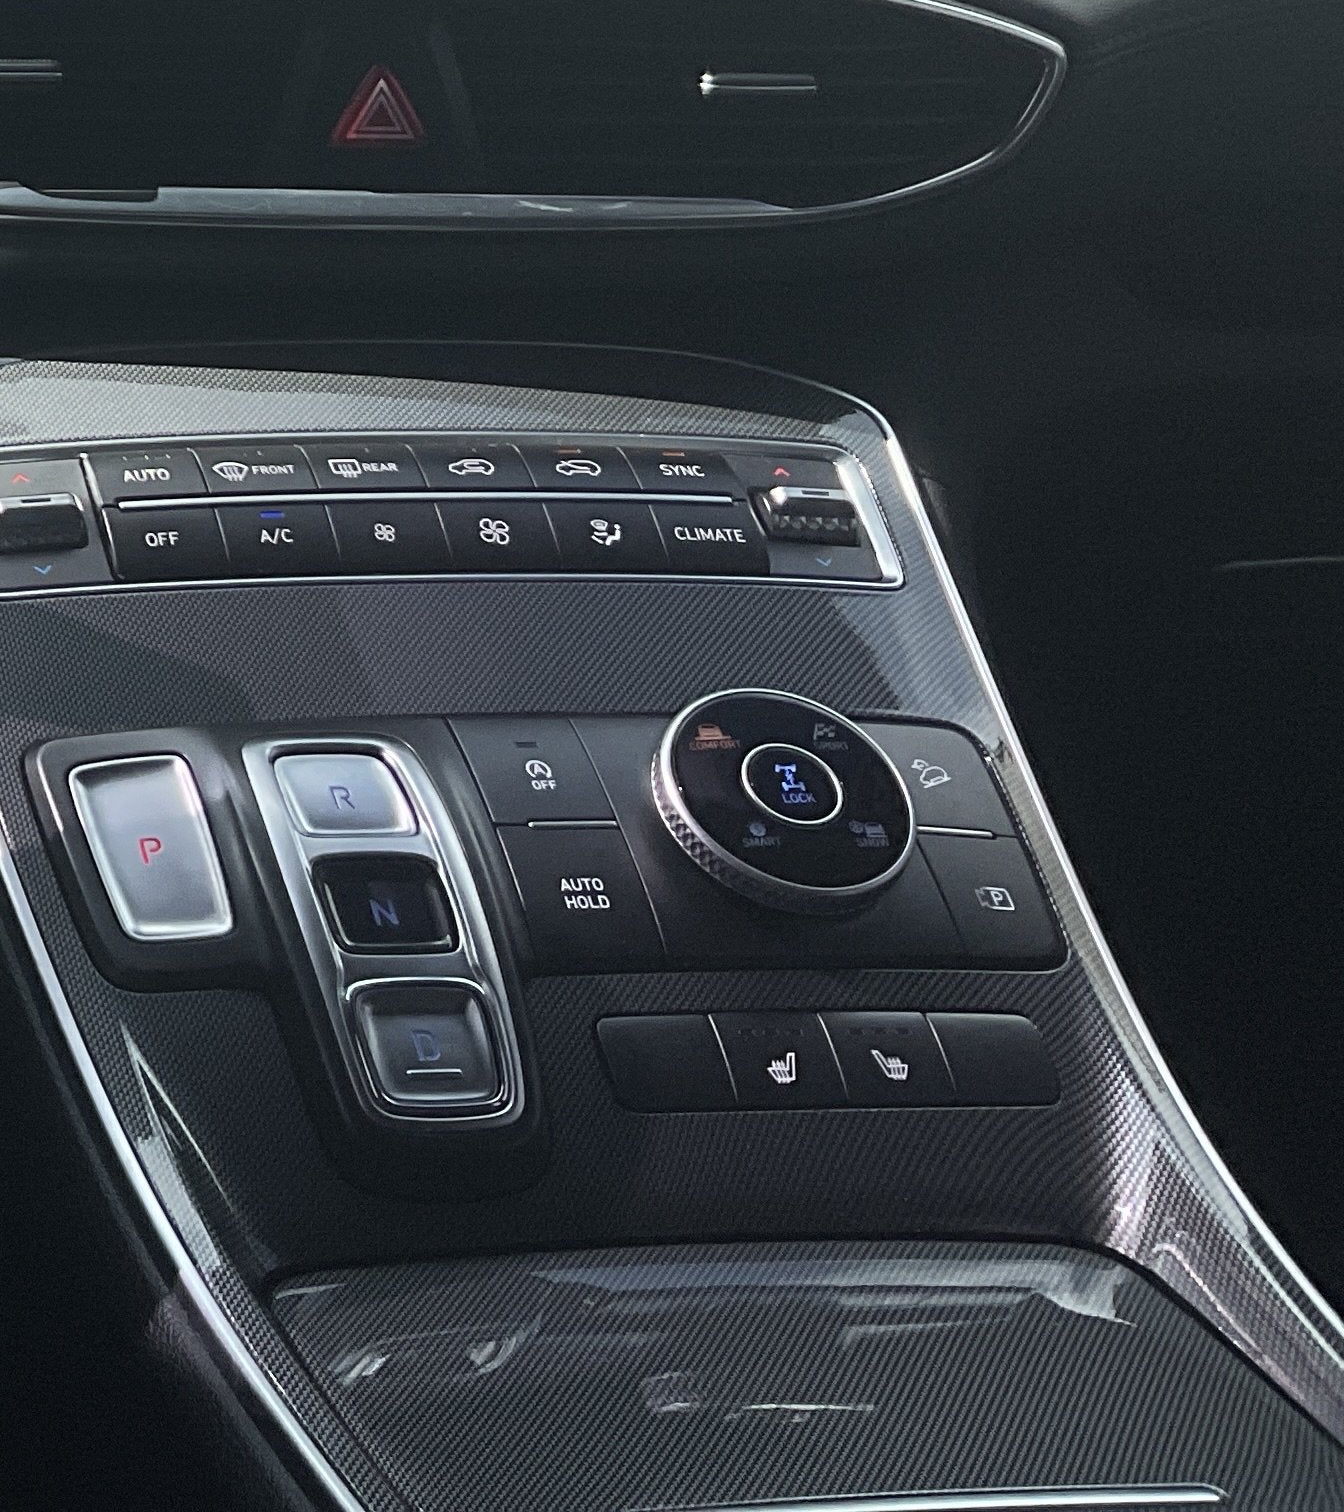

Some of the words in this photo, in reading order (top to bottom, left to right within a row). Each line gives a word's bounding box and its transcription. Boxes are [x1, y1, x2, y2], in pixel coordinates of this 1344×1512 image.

[123, 467, 170, 483] AUTO
[252, 464, 295, 476] FRONT
[362, 461, 398, 474] REAR
[659, 463, 705, 478] SYNC
[145, 531, 179, 547] OFF
[260, 528, 294, 544] A/C
[674, 526, 746, 544] CLIMATE
[689, 739, 742, 751] COMFORT
[531, 779, 556, 791] OFF
[329, 786, 353, 809] R
[782, 792, 817, 805] LOCK
[139, 836, 162, 864] P
[742, 837, 781, 847] SMART
[560, 877, 604, 893] AUTO
[565, 894, 610, 911] HOLD
[369, 898, 400, 927] N
[412, 1030, 442, 1062] D
